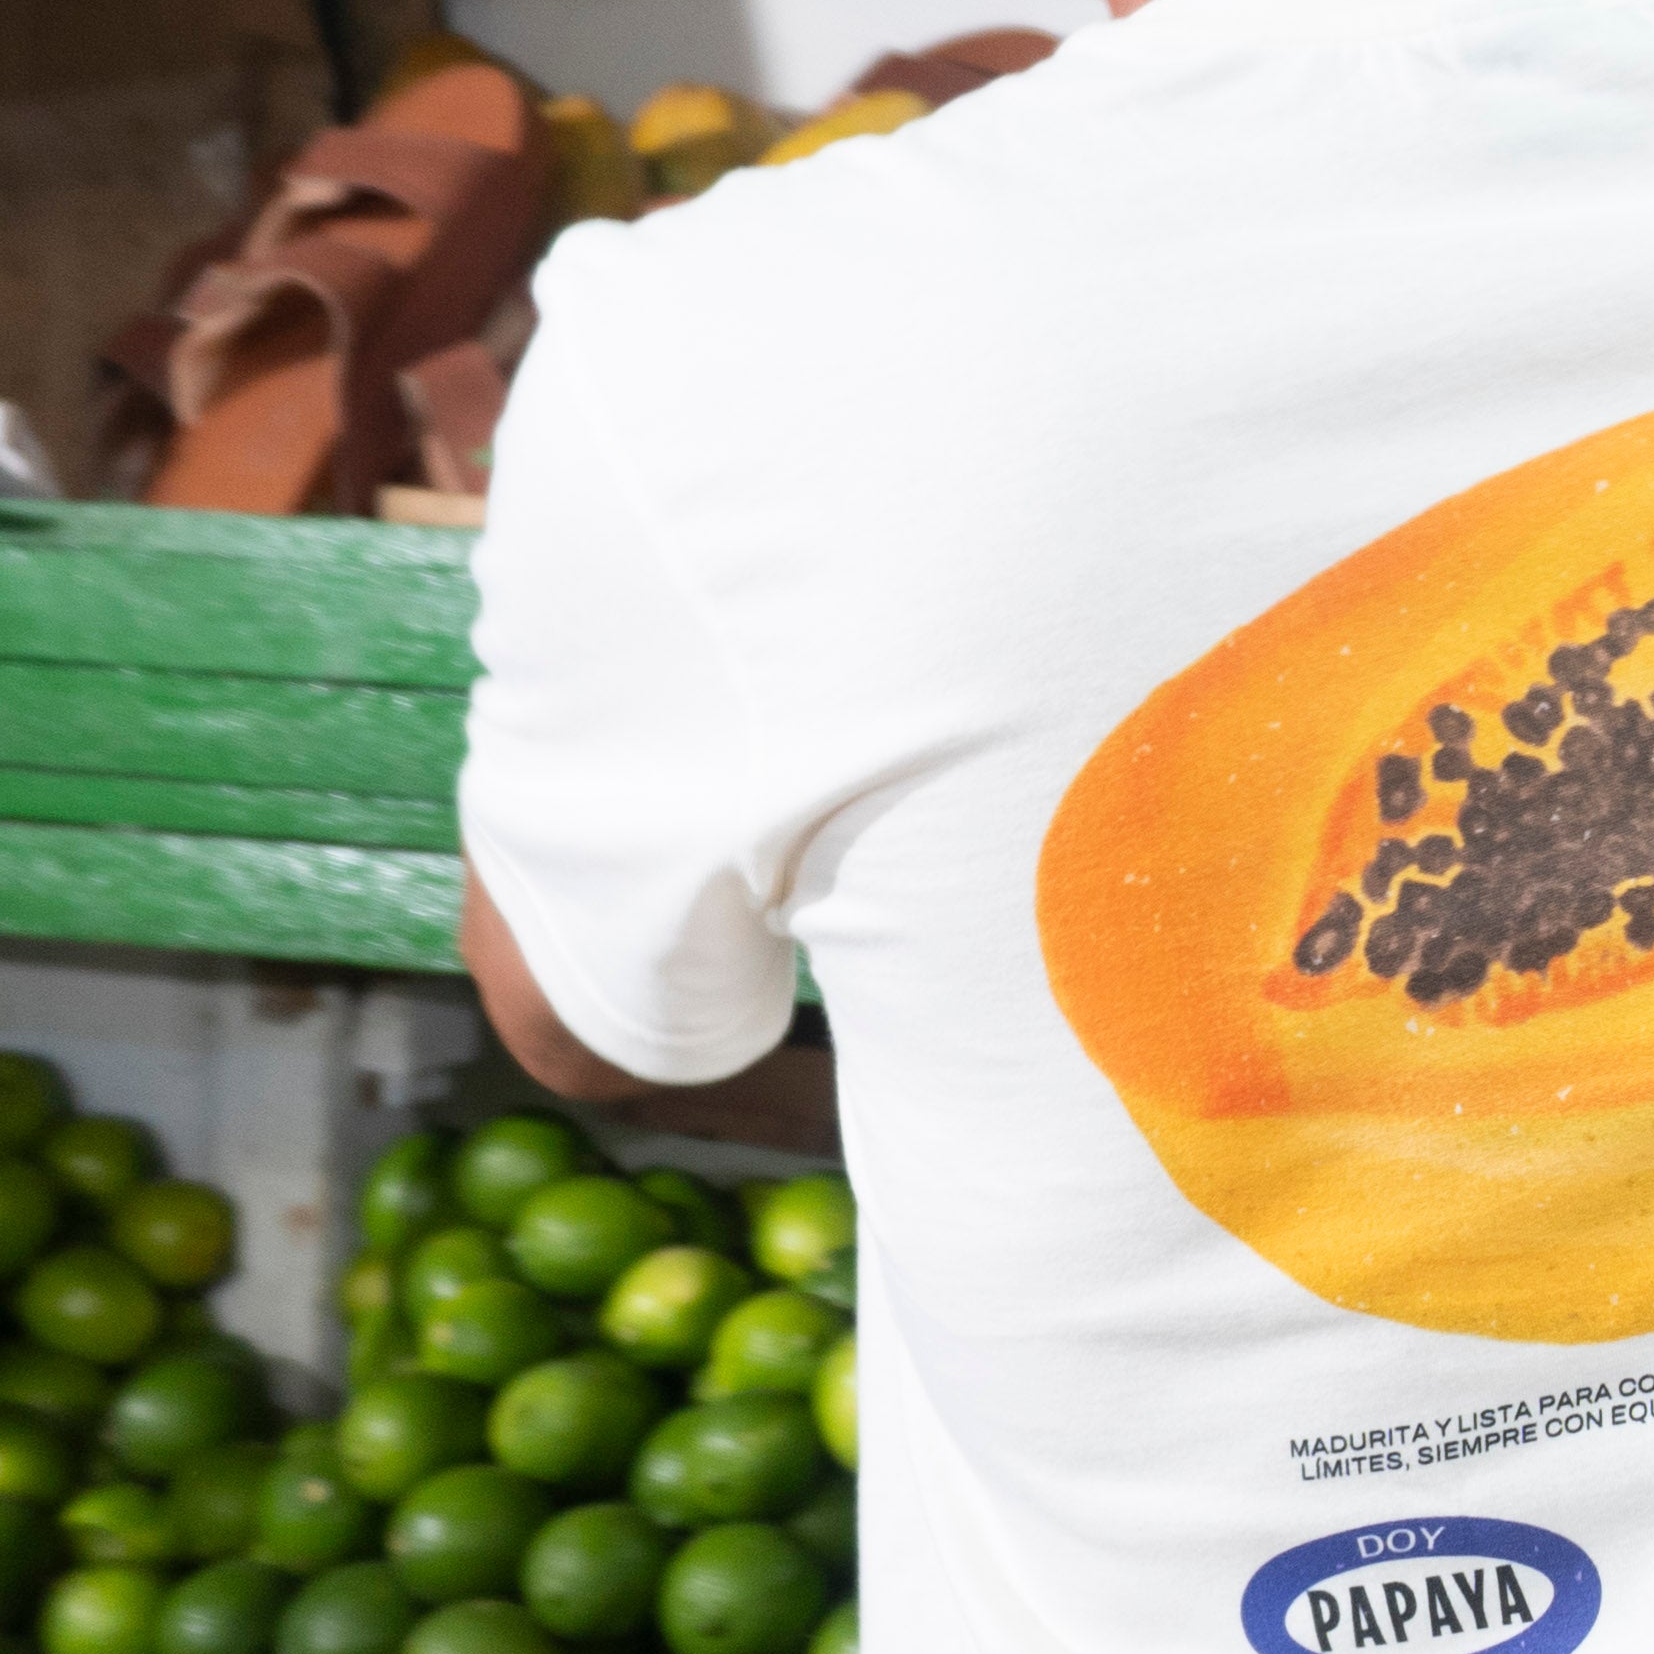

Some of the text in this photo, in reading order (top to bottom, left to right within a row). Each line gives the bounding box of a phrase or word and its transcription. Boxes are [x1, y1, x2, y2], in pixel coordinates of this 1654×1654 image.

[1290, 1422, 1430, 1458] MADURITA
[1434, 1417, 1453, 1438] Y
[1457, 1401, 1532, 1434] LISTA
[1539, 1383, 1612, 1415] PARA
[1301, 1452, 1411, 1481] LÍMITES,
[1417, 1423, 1538, 1466] SIEMPRE
[1545, 1410, 1603, 1438] CON
[1356, 1526, 1445, 1559] DOY
[1306, 1563, 1535, 1653] PAPAYA
